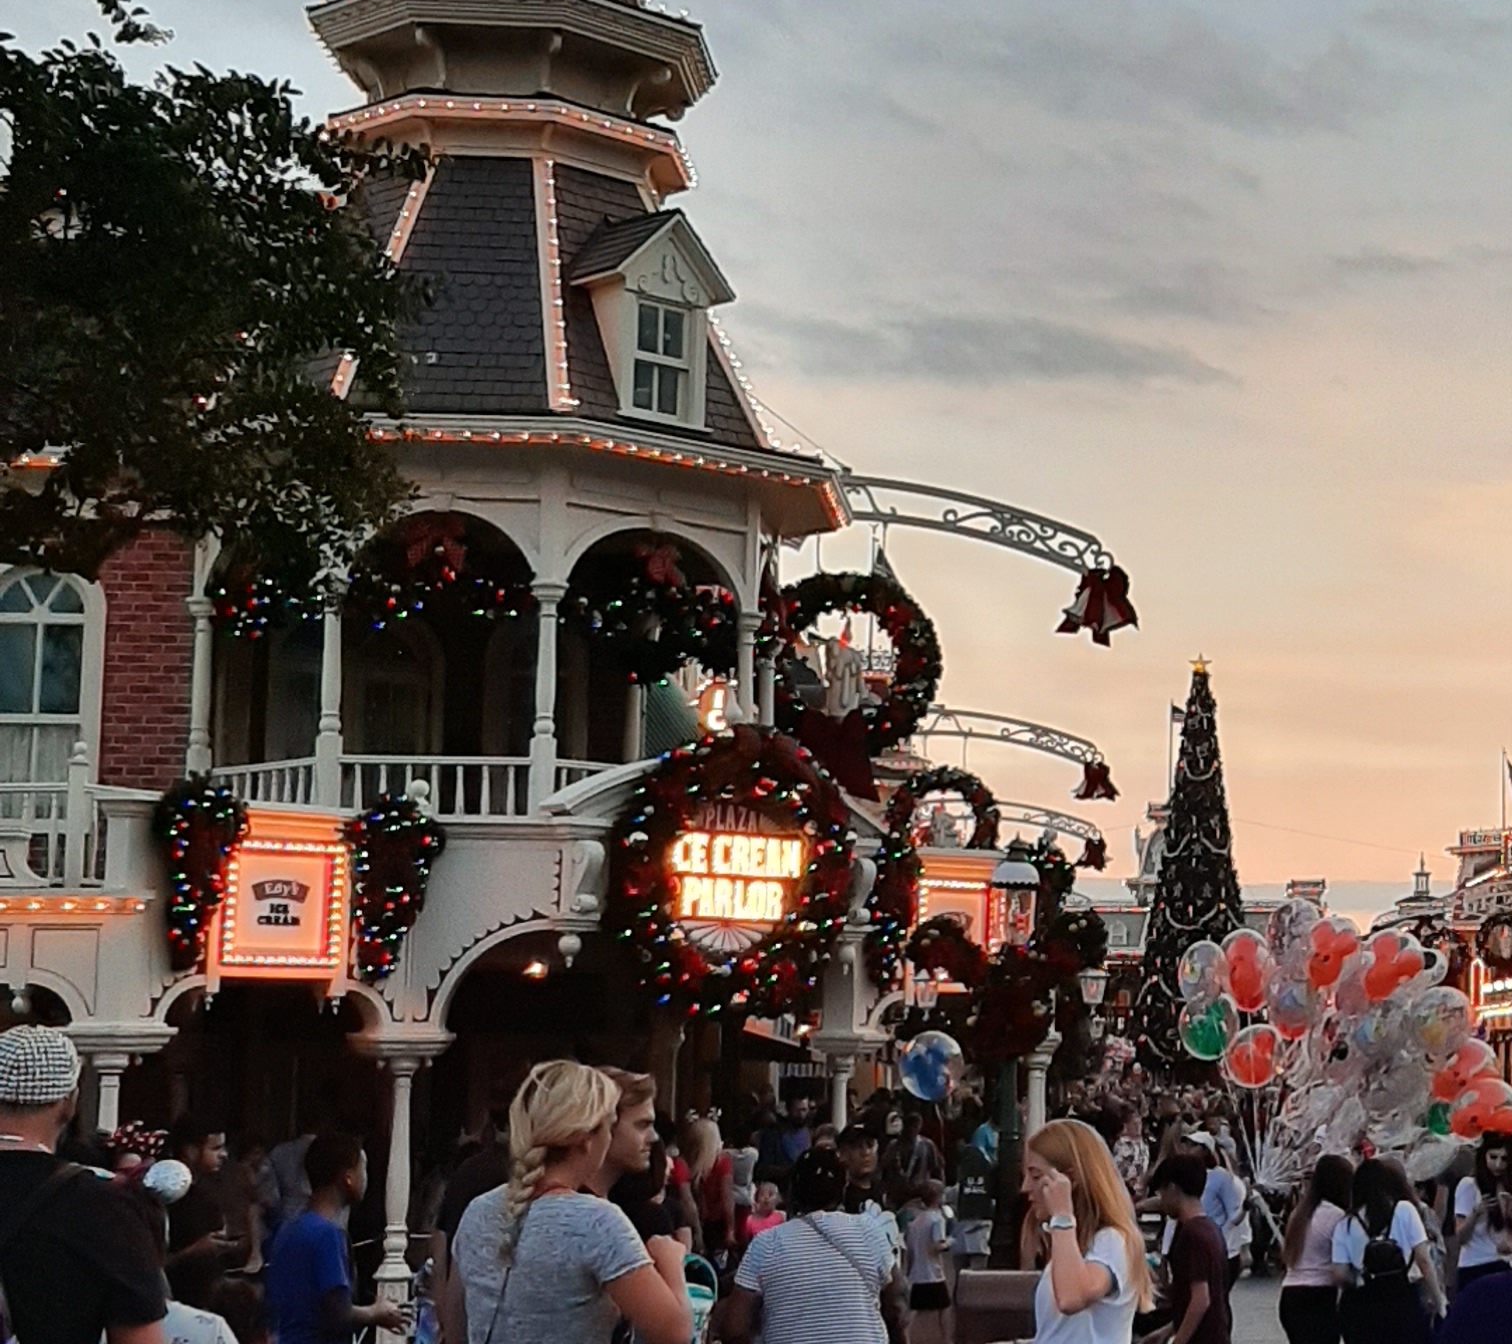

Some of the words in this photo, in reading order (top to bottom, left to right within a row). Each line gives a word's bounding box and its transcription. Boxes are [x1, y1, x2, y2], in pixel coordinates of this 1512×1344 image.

[705, 803, 758, 832] PLAZA
[671, 831, 711, 874] CE
[711, 834, 802, 879] CREAM
[269, 903, 290, 914] ICE
[680, 876, 784, 921] PARLOR
[256, 915, 301, 926] CREAM
